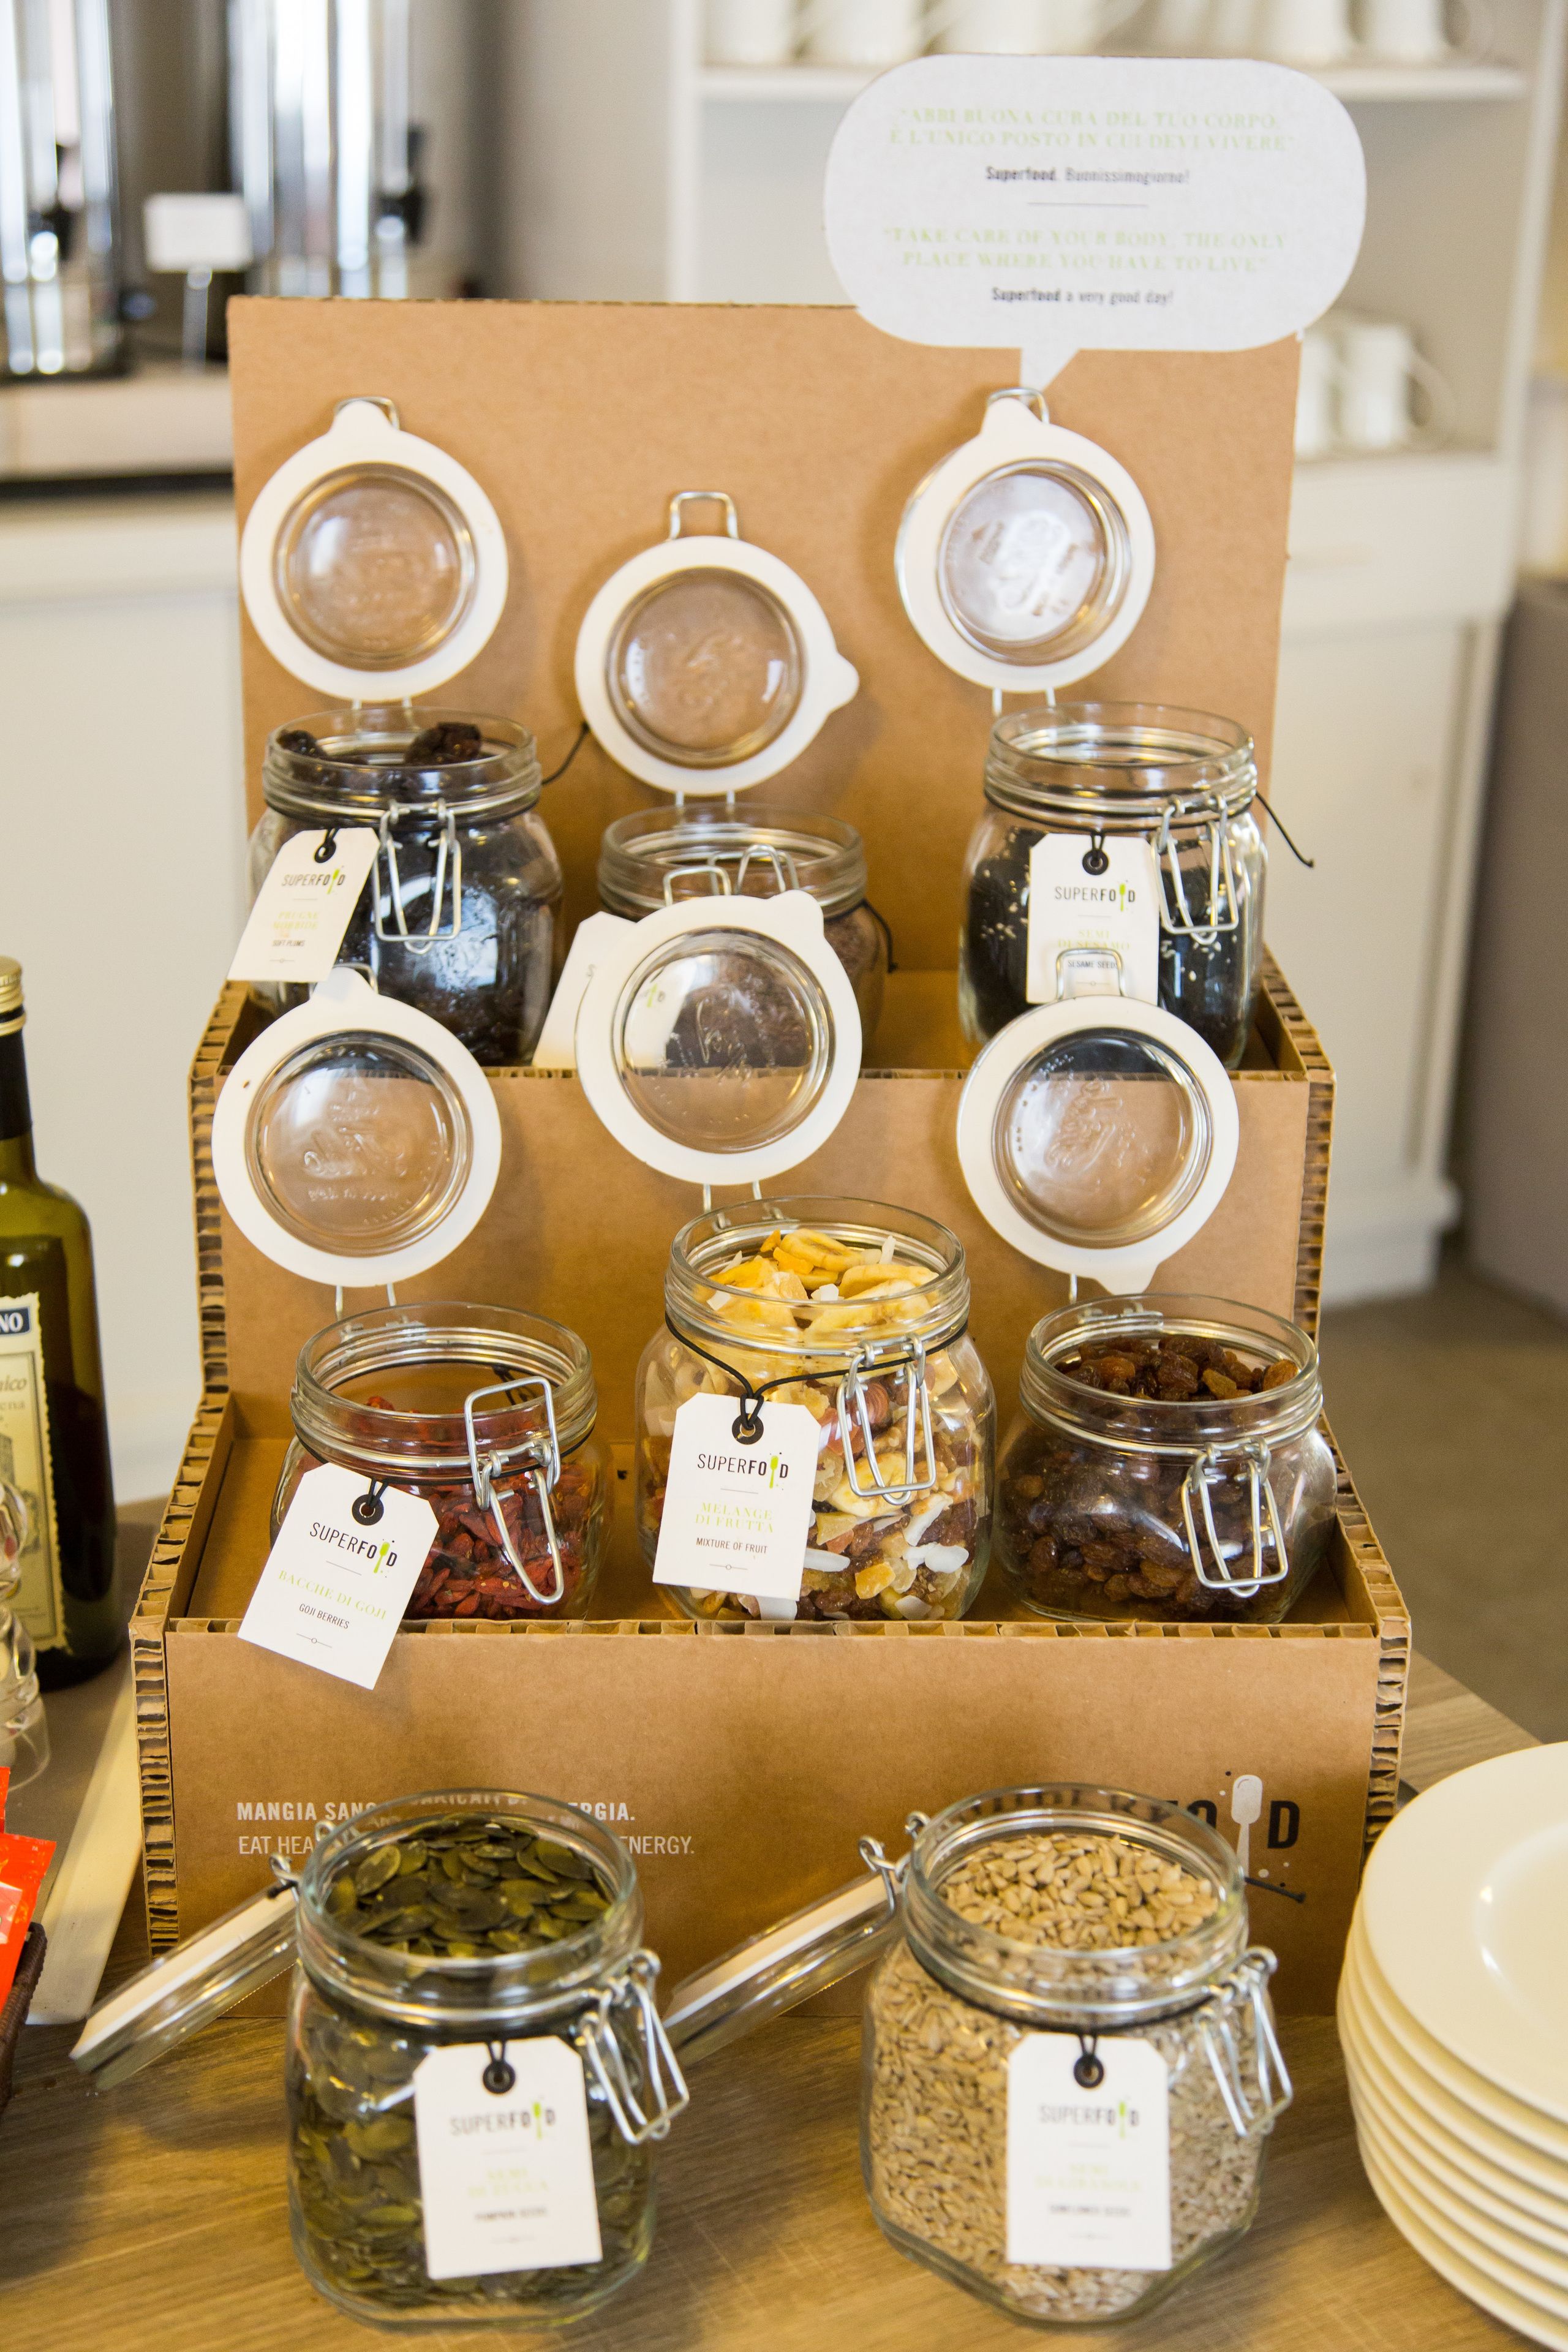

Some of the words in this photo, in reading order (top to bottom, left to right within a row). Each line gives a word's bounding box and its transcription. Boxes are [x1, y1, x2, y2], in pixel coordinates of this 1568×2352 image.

[1106, 110, 1147, 126] DEL
[1156, 111, 1197, 127] TUO
[1001, 131, 1071, 147] POSTO
[1077, 132, 1098, 147] IN
[1106, 134, 1141, 148] CUI
[955, 228, 1010, 244] CARE
[1016, 229, 1042, 244] OF
[1050, 229, 1107, 246] YOUR
[1183, 232, 1225, 248] THE
[1231, 233, 1284, 250] ONLY
[903, 251, 971, 268] PLACE
[977, 251, 1052, 268] WHERE
[1059, 253, 1098, 270] YOU
[1109, 254, 1167, 271] HAVE
[1172, 255, 1202, 271] TO
[992, 286, 1061, 304] Superfood
[1065, 291, 1074, 302] a
[1078, 290, 1105, 305] very
[1109, 289, 1140, 306] good
[1055, 886, 1136, 905] SUPERFOD
[1068, 960, 1095, 968] SESAME
[696, 1453, 789, 1479] SUPERFOD
[715, 1516, 774, 1534] FRUTTA
[309, 1521, 398, 1567] SUPERFOD
[695, 1537, 731, 1550] MIXTURE
[732, 1541, 743, 1551] OF
[744, 1543, 768, 1555] FRUIT
[278, 1569, 334, 1600] BACCHE
[336, 1592, 352, 1607] DI
[354, 1600, 387, 1621] GOJI
[298, 1603, 317, 1616] GOJI
[316, 1609, 350, 1630] BERRIES
[236, 1801, 317, 1821] MANGIA
[238, 1836, 272, 1855] EAT
[619, 1835, 695, 1855] NERGY.
